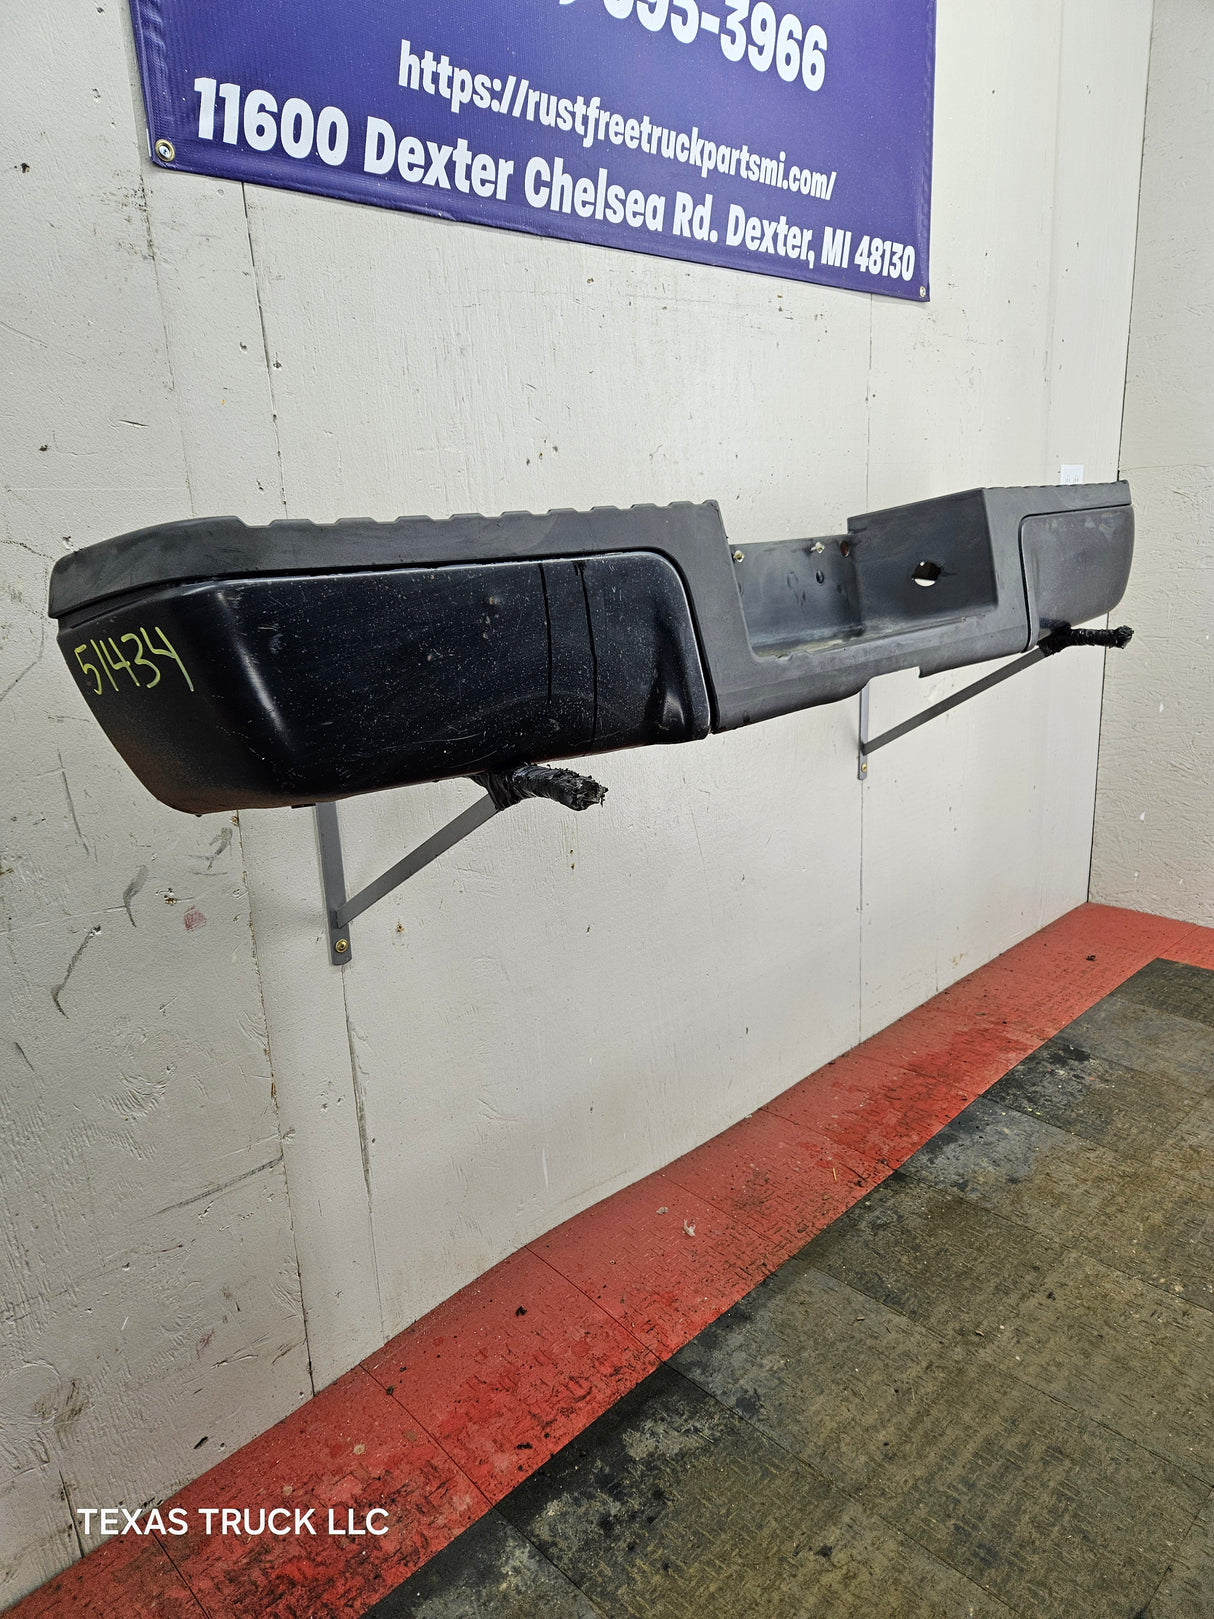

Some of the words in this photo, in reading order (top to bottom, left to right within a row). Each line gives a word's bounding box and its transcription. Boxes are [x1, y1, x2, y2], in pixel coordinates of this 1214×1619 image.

[193, 76, 349, 167] 11600
[363, 115, 515, 201] Dexter
[524, 155, 666, 233] Chelsea
[672, 190, 719, 244] Rd.
[724, 202, 816, 270] Dexter,
[820, 225, 853, 269] MI
[853, 234, 916, 282] 48130
[398, 38, 838, 201] https://rustfreetruckpartsmi.com/
[74, 626, 194, 696] 51434
